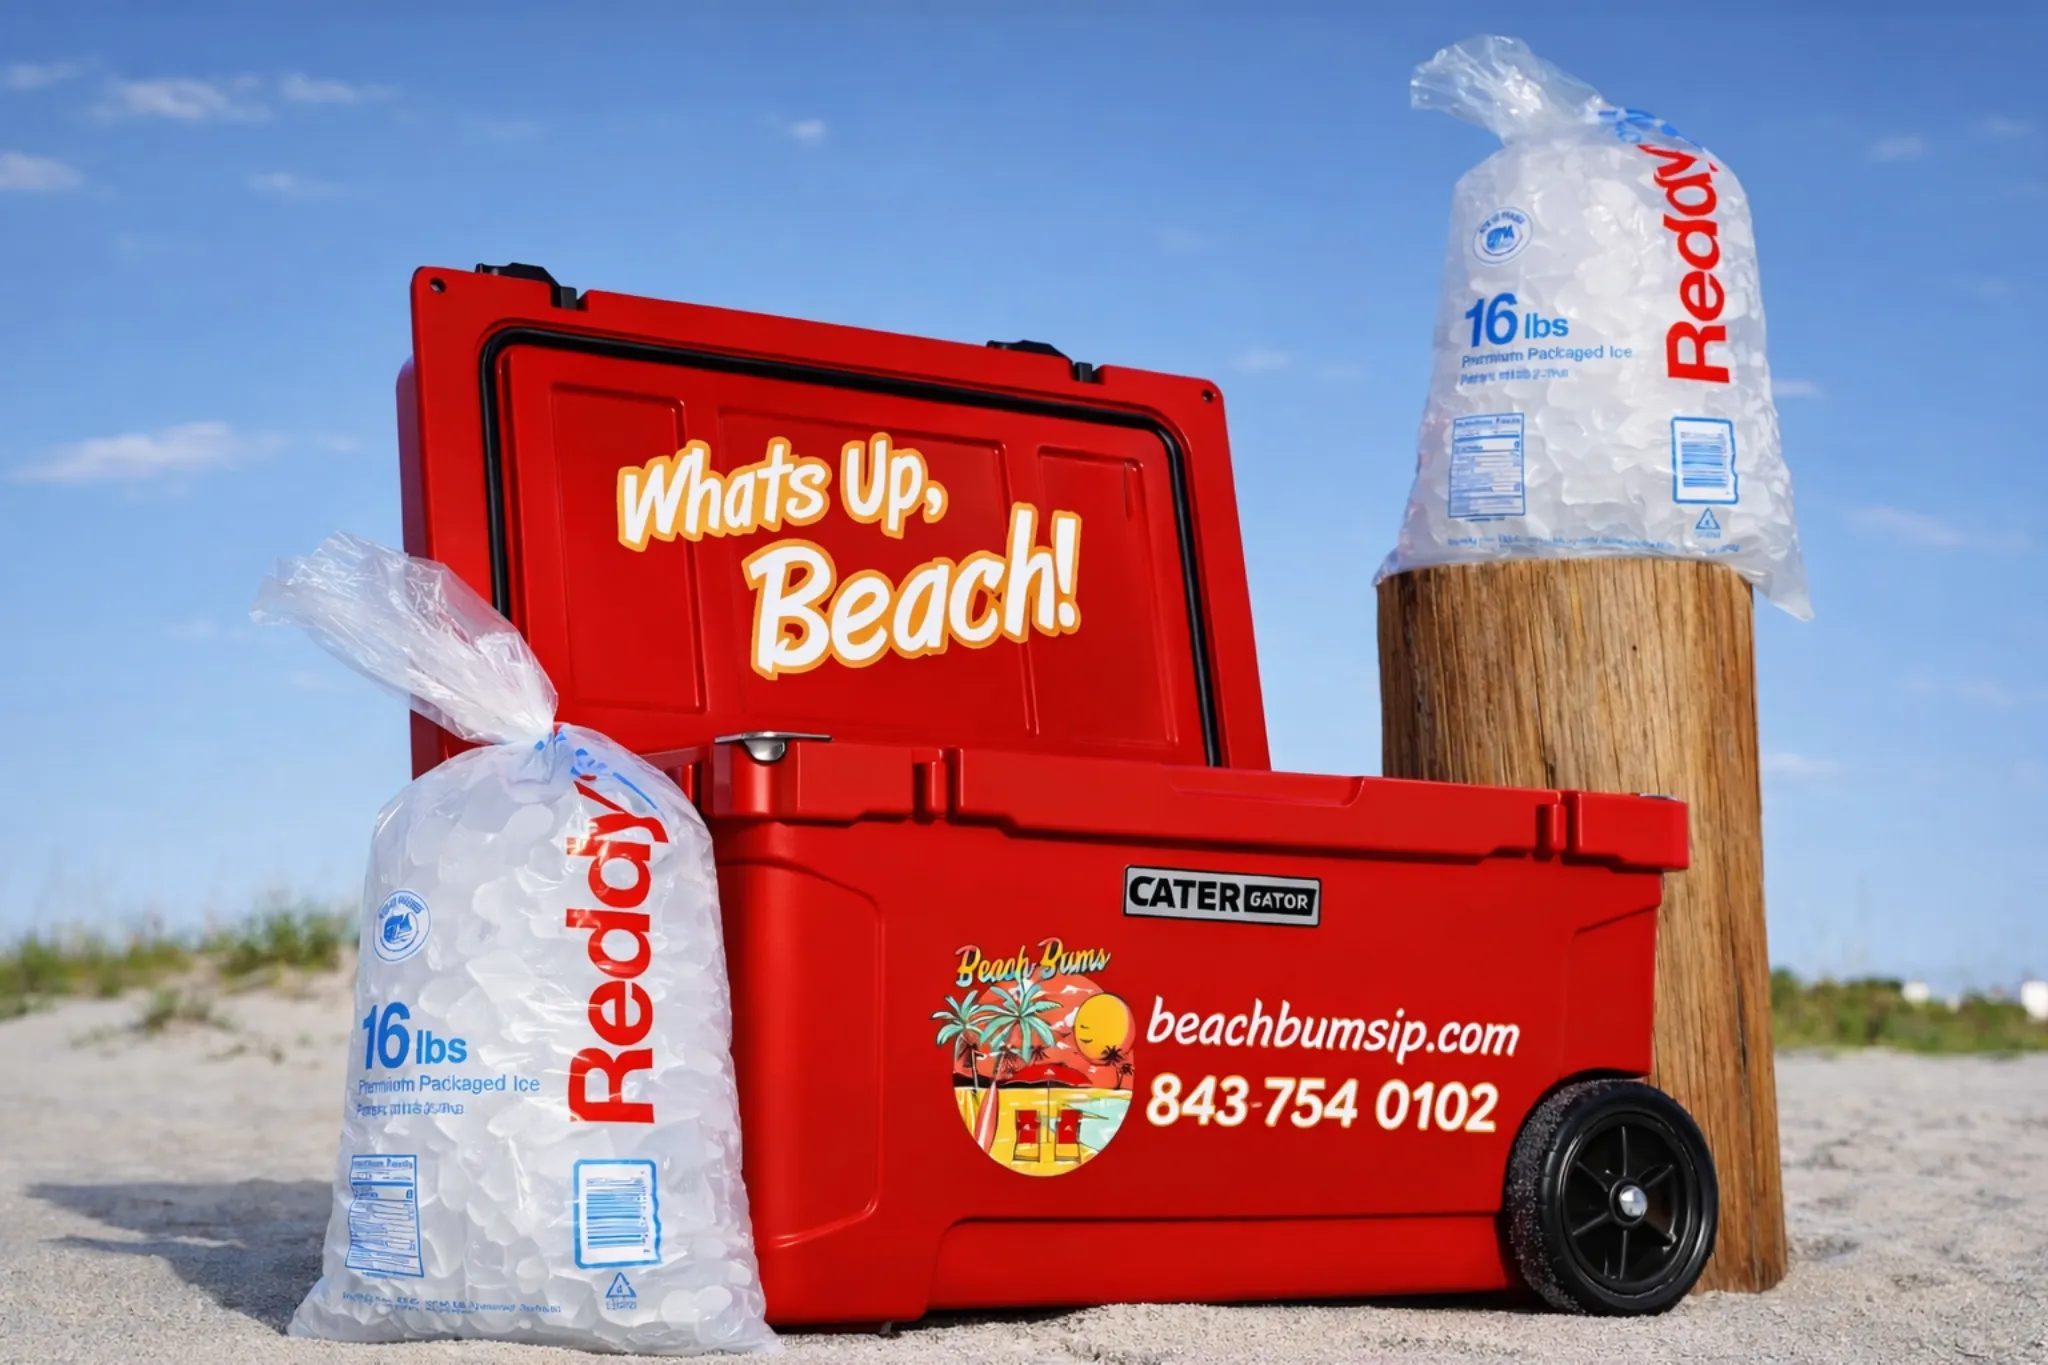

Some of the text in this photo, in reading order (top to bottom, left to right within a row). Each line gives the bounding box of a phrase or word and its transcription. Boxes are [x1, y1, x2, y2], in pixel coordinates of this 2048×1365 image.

[1465, 292, 1569, 348] 16 lbs
[1527, 345, 1604, 361] Packaged
[1609, 345, 1632, 358] Ice
[617, 432, 948, 552] Whats Up,
[741, 502, 1082, 681] Beach!
[1129, 876, 1308, 912] CATER GATOR
[566, 773, 670, 1124] Ready
[955, 936, 1112, 988] Beach Bums
[362, 1002, 468, 1070] 16 lbs
[1146, 996, 1520, 1065] beachbumsip.com
[419, 1074, 506, 1095] Packaged
[513, 1074, 541, 1091] Ice
[1375, 1081, 1499, 1133] 0102
